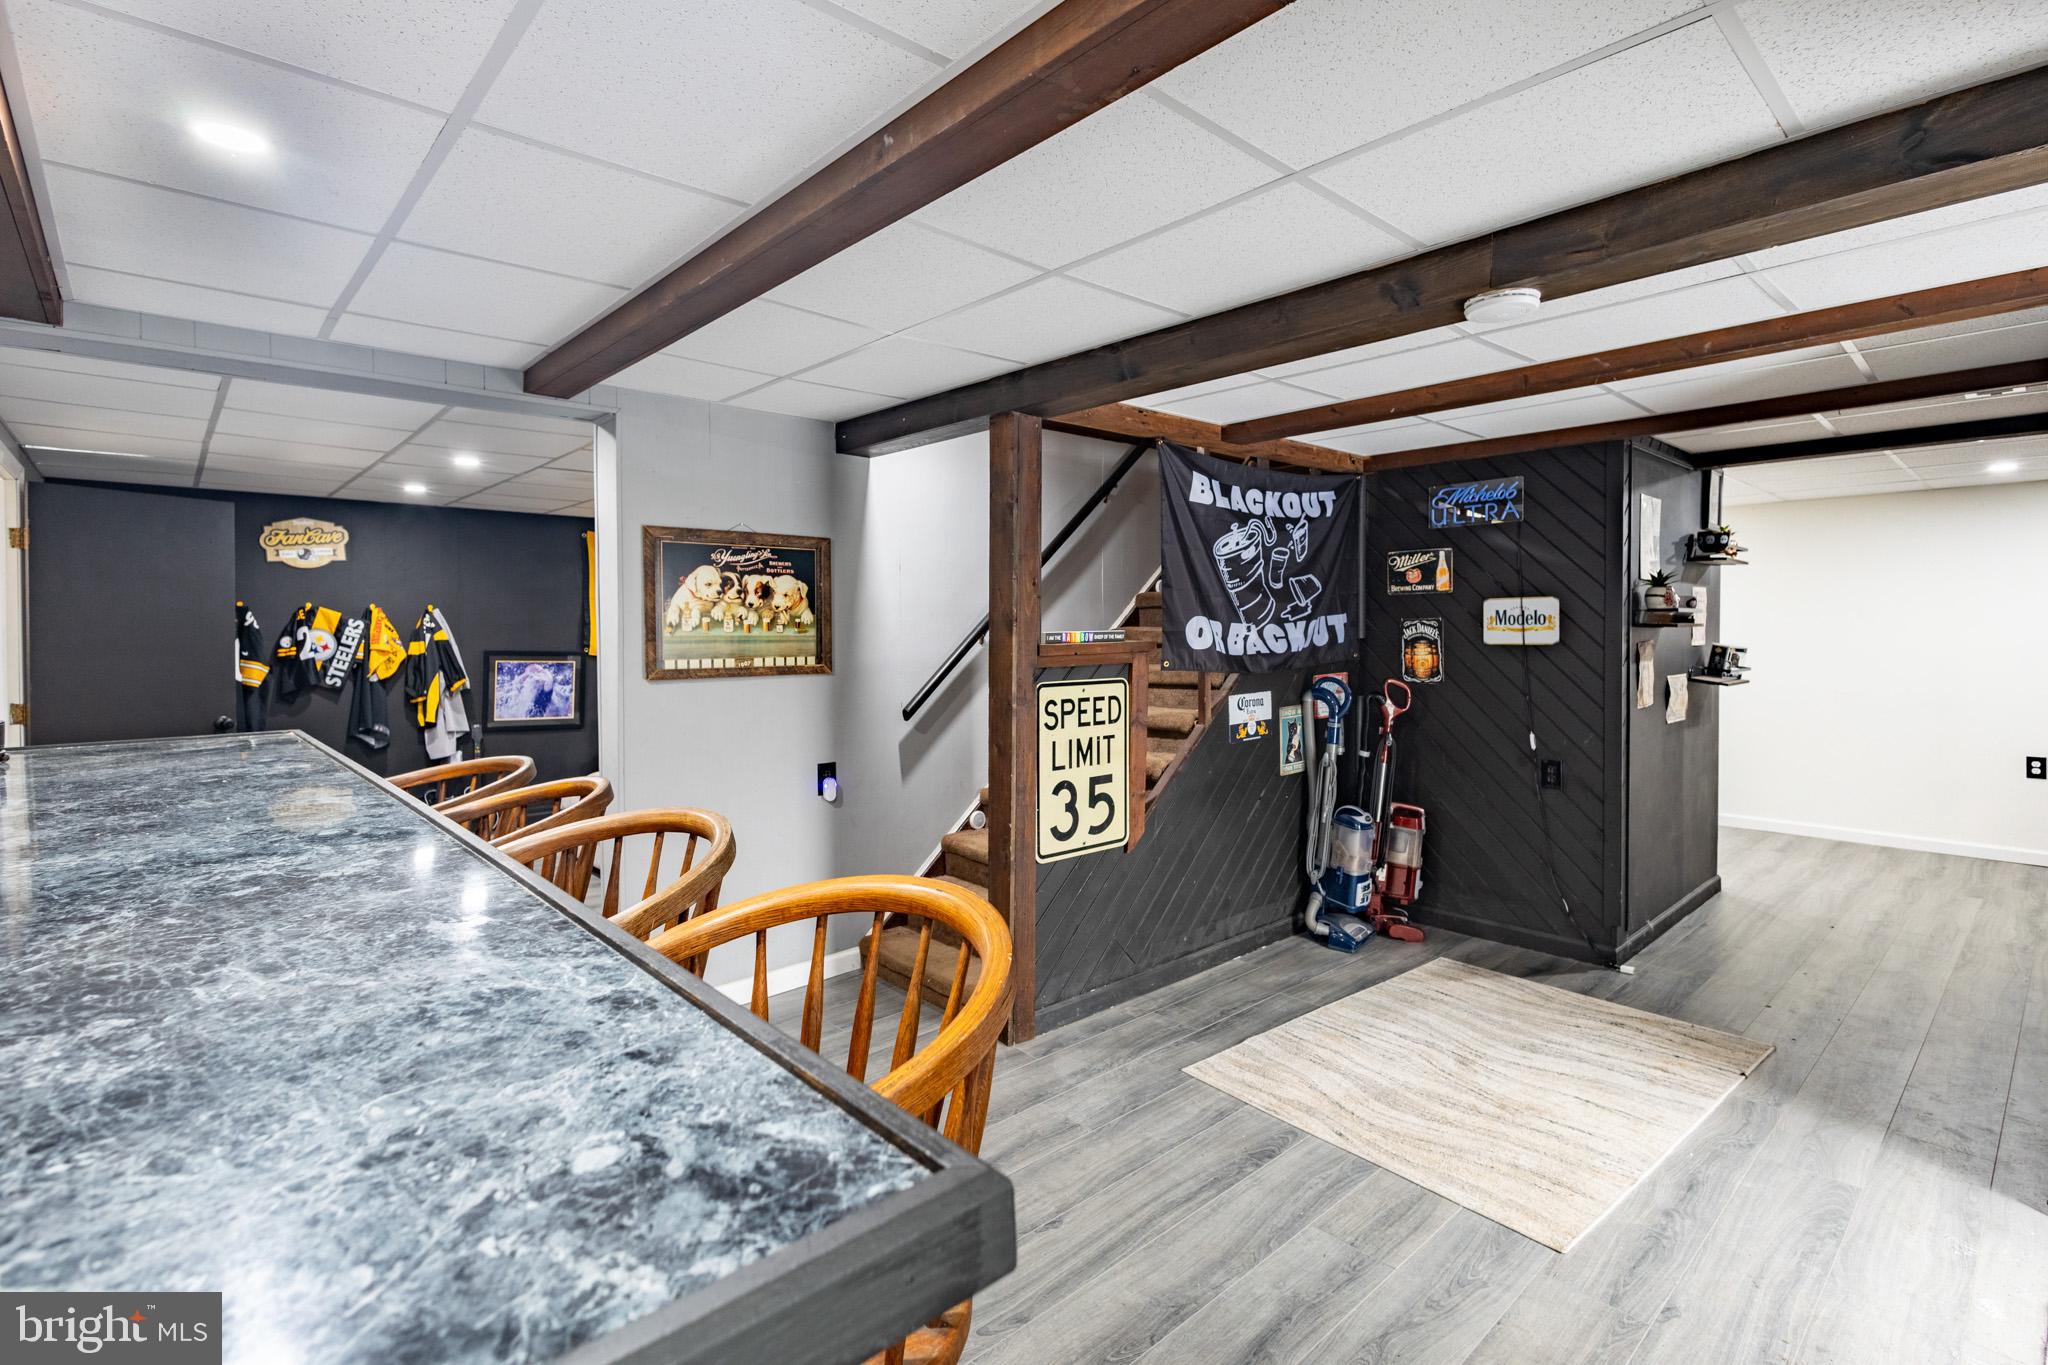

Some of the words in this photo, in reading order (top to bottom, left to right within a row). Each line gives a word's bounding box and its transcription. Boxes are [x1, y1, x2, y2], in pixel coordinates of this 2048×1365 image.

[1189, 470, 1336, 518] BLACKOUT
[1432, 481, 1519, 509] Michelob
[1432, 500, 1520, 526] ULTRA
[1389, 552, 1436, 572] Miller
[1185, 615, 1227, 655] OR
[1495, 609, 1546, 626] Modelo
[325, 618, 365, 687] STEELERS
[1043, 695, 1122, 731] SPEED
[1237, 696, 1264, 711] Corona
[1051, 734, 1115, 772] LIMIT
[1050, 773, 1115, 842] 35
